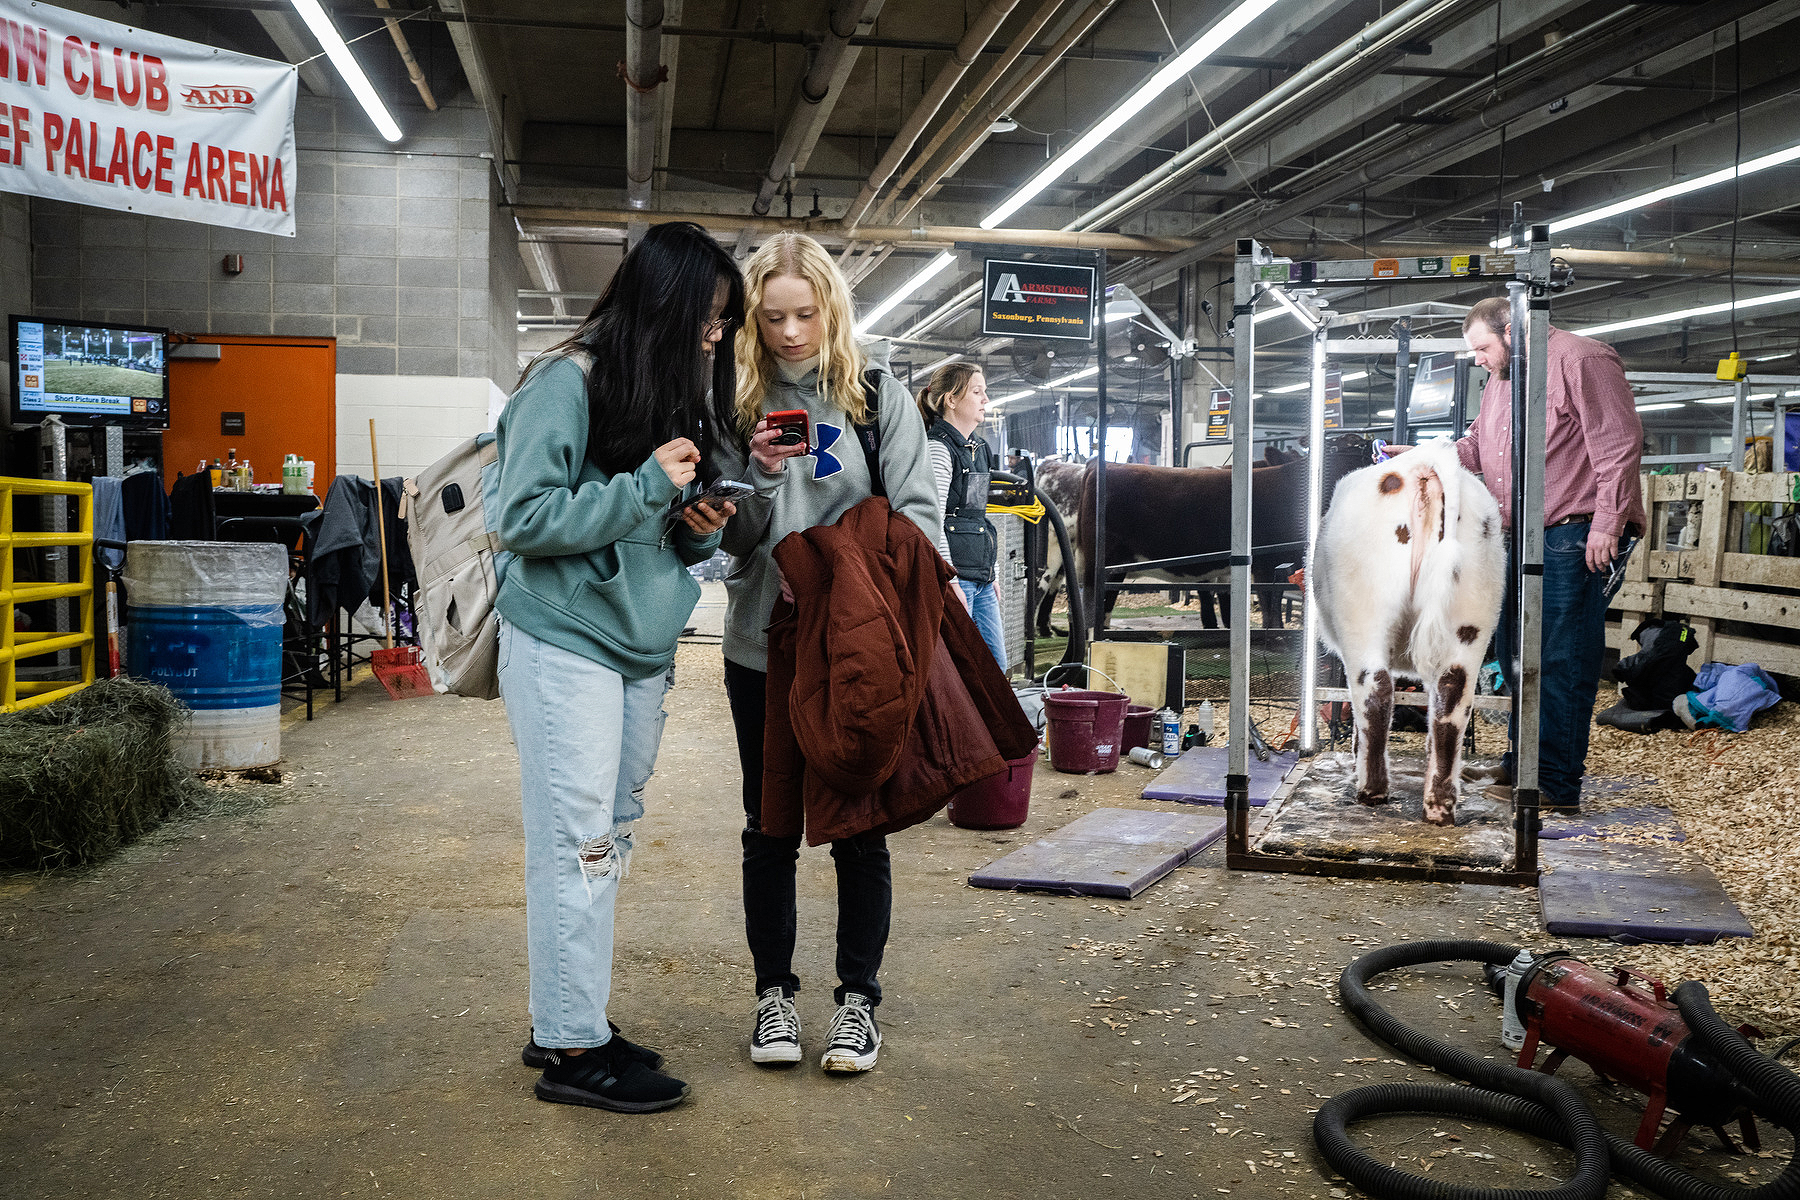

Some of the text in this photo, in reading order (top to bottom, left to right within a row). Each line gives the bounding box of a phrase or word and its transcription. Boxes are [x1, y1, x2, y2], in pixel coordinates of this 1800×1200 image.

[62, 35, 170, 113] CLUB
[183, 89, 255, 105] AND
[43, 112, 174, 194] PALACE
[183, 142, 287, 213] ARENA
[1021, 283, 1088, 295] ARMSTRONG
[1026, 296, 1057, 305] FARMS
[992, 311, 1084, 325] Saxonburg, Pennsylvania
[75, 396, 99, 404] Picture
